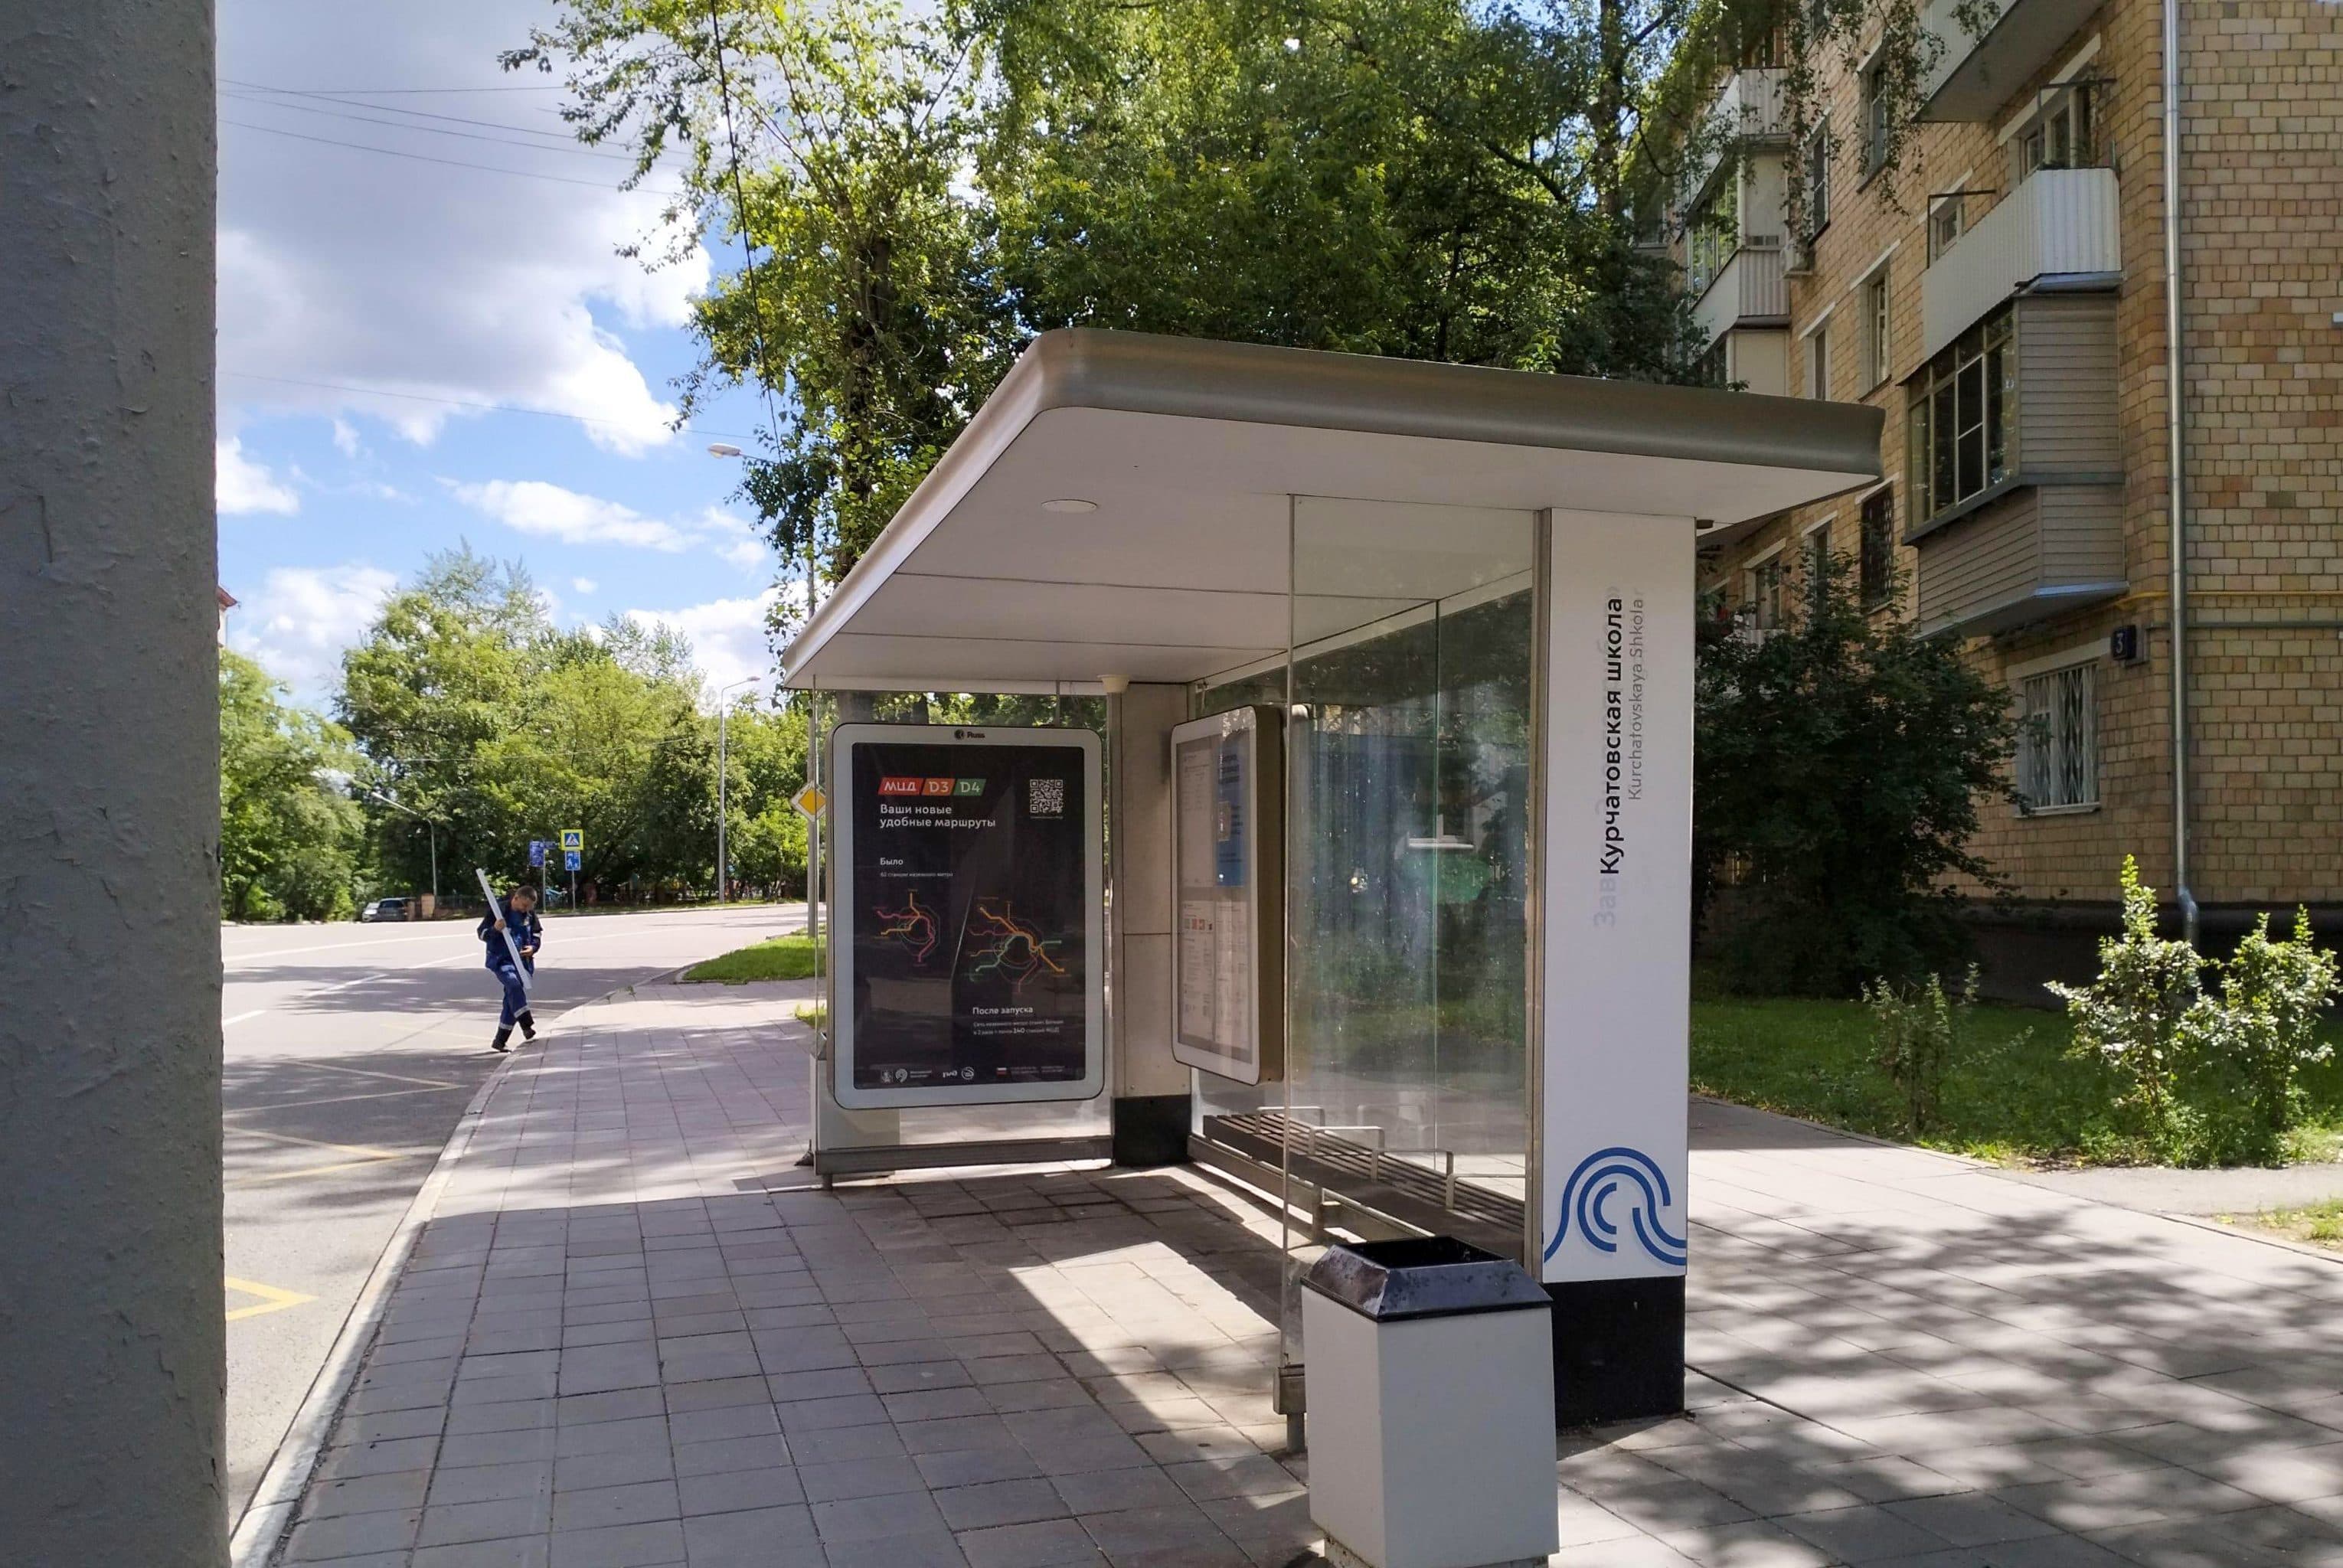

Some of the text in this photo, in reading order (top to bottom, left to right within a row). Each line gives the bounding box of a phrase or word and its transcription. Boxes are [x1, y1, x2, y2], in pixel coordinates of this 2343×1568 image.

[1629, 599, 1644, 658] Shkola
[1607, 598, 1622, 681] школа
[1628, 663, 1645, 800] Kurchatovskaya
[884, 781, 980, 792] МЦД D3 D4
[1600, 690, 1624, 874] Курчатовская
[880, 804, 912, 814] Ваши
[880, 816, 995, 828] удобные маршруты
[880, 857, 904, 865] Было
[972, 1006, 1033, 1016] После запуска
